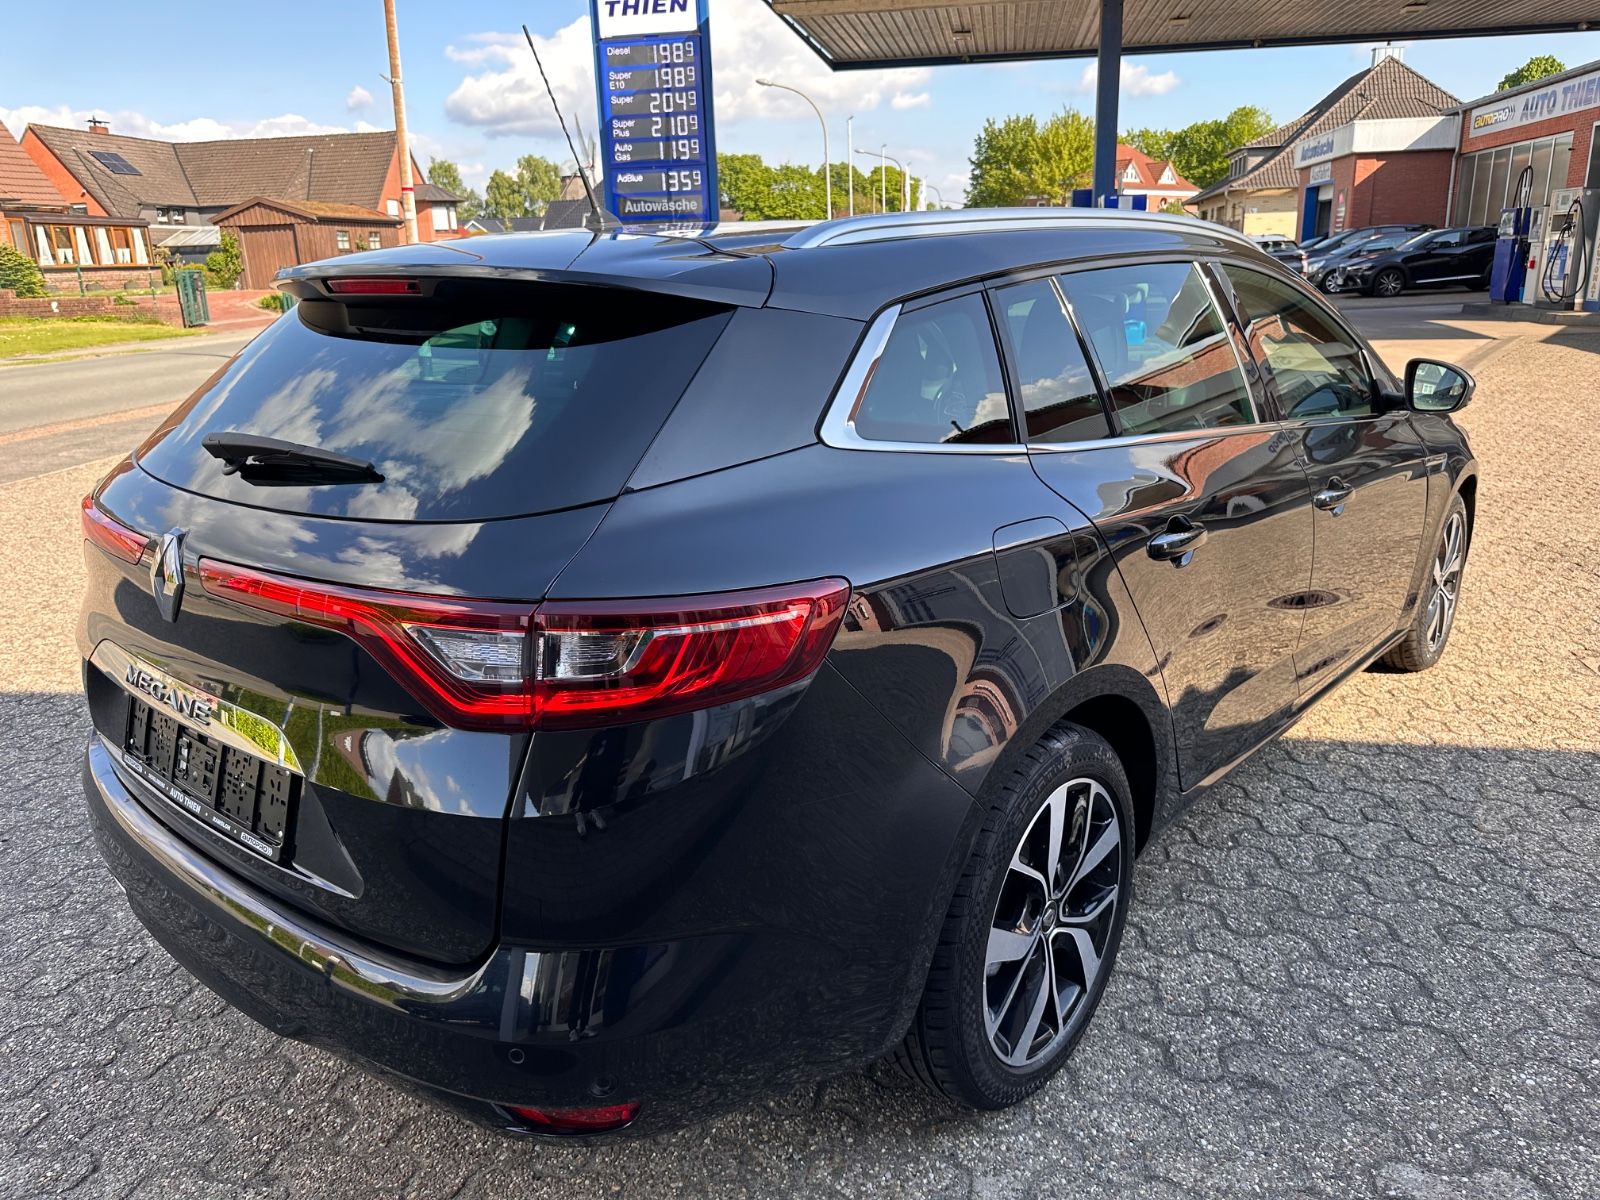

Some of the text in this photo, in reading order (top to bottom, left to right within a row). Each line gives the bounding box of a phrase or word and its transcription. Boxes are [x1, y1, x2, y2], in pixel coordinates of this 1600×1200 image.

[605, 0, 688, 17] THIEN
[607, 41, 694, 63] Diesel 1989
[608, 66, 695, 88] Super 1989
[609, 81, 625, 90] E10
[610, 91, 697, 114] Super 2049
[1520, 89, 1558, 122] AUTO
[612, 115, 698, 137] Super 2109
[612, 129, 630, 138] Plus
[614, 139, 700, 160] Auto 1199
[614, 152, 631, 161] Gas
[616, 170, 701, 192] AdBlue 1359
[624, 198, 698, 213] Autowäsche
[126, 663, 212, 726] MEGANE
[169, 787, 184, 802] AUTO
